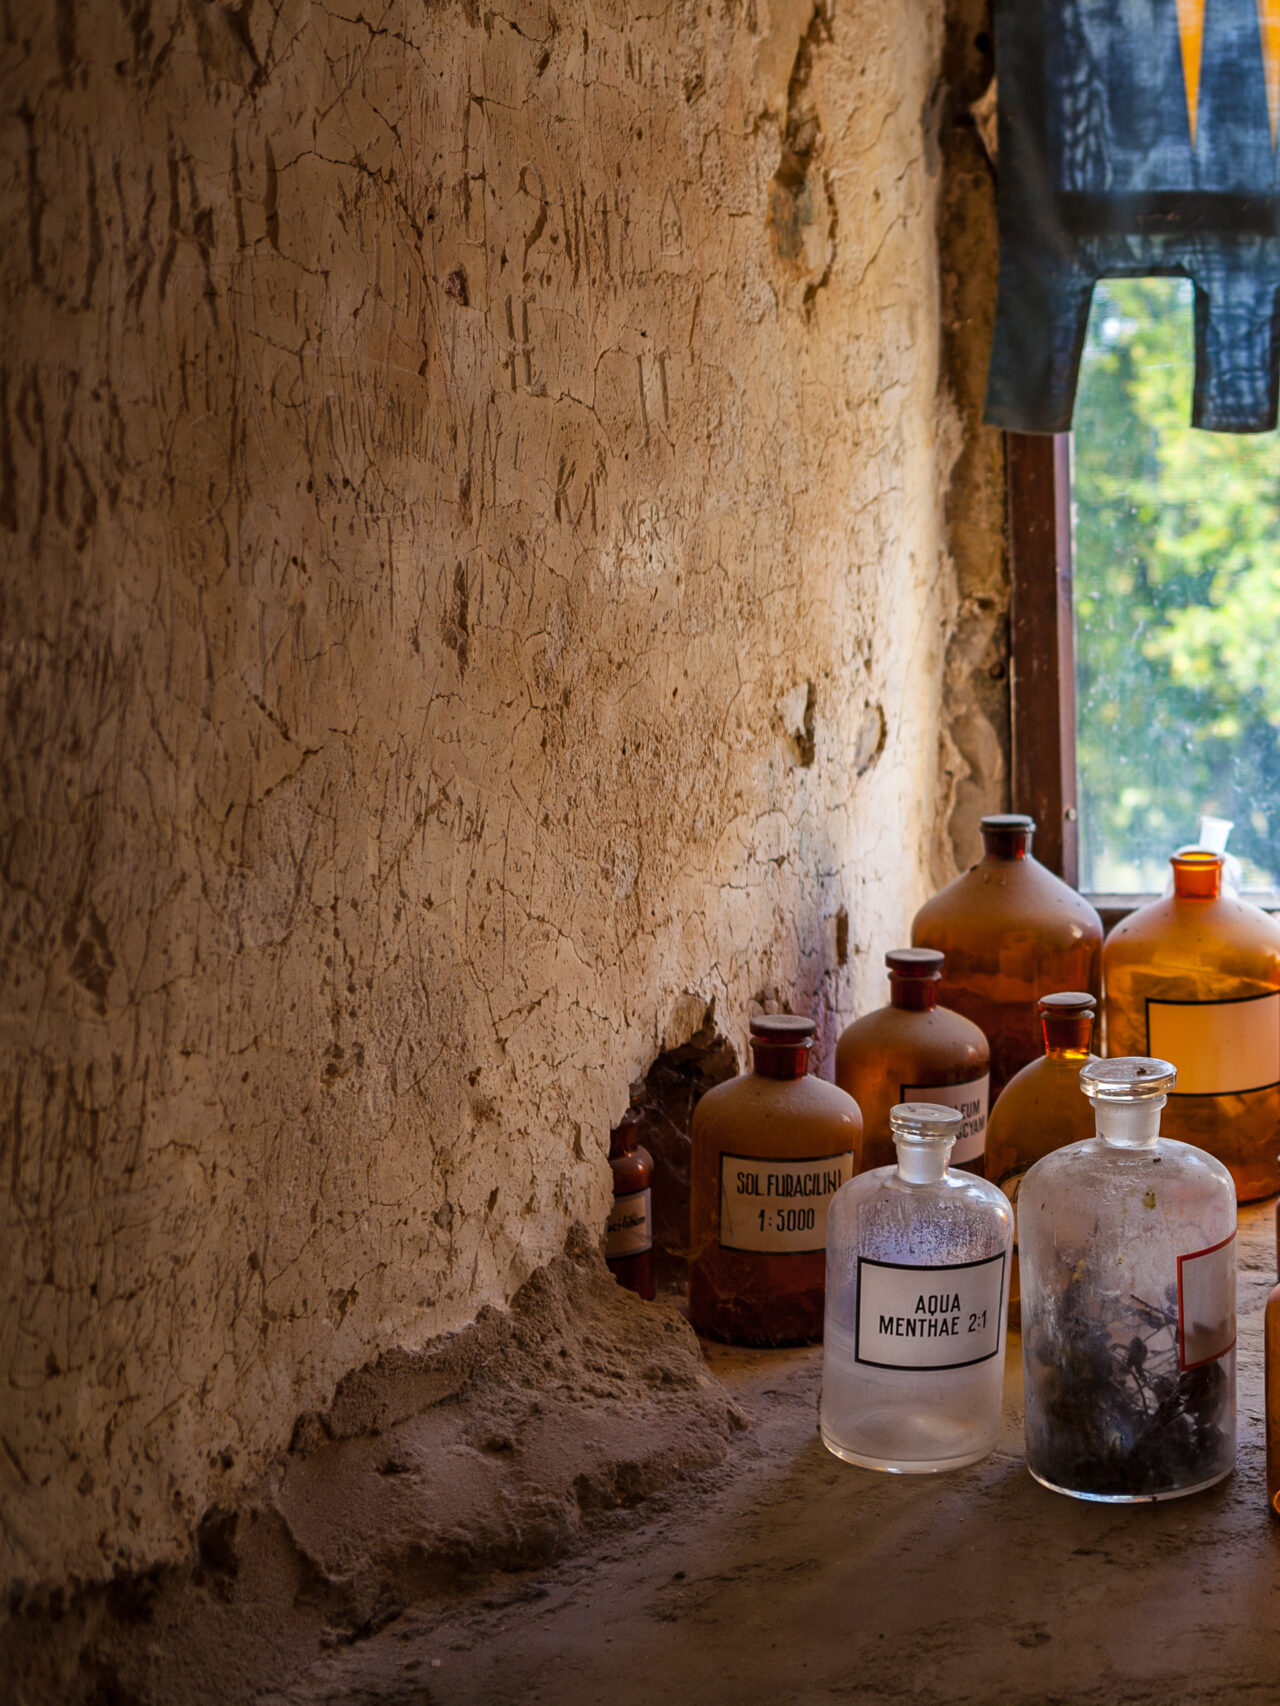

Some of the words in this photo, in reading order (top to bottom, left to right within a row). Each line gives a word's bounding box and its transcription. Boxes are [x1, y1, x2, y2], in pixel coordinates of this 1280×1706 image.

[767, 1168, 842, 1198] FURACILINI
[915, 1293, 961, 1316] AQUA
[879, 1315, 960, 1338] MENTHAE
[968, 1309, 987, 1333] 2:1
